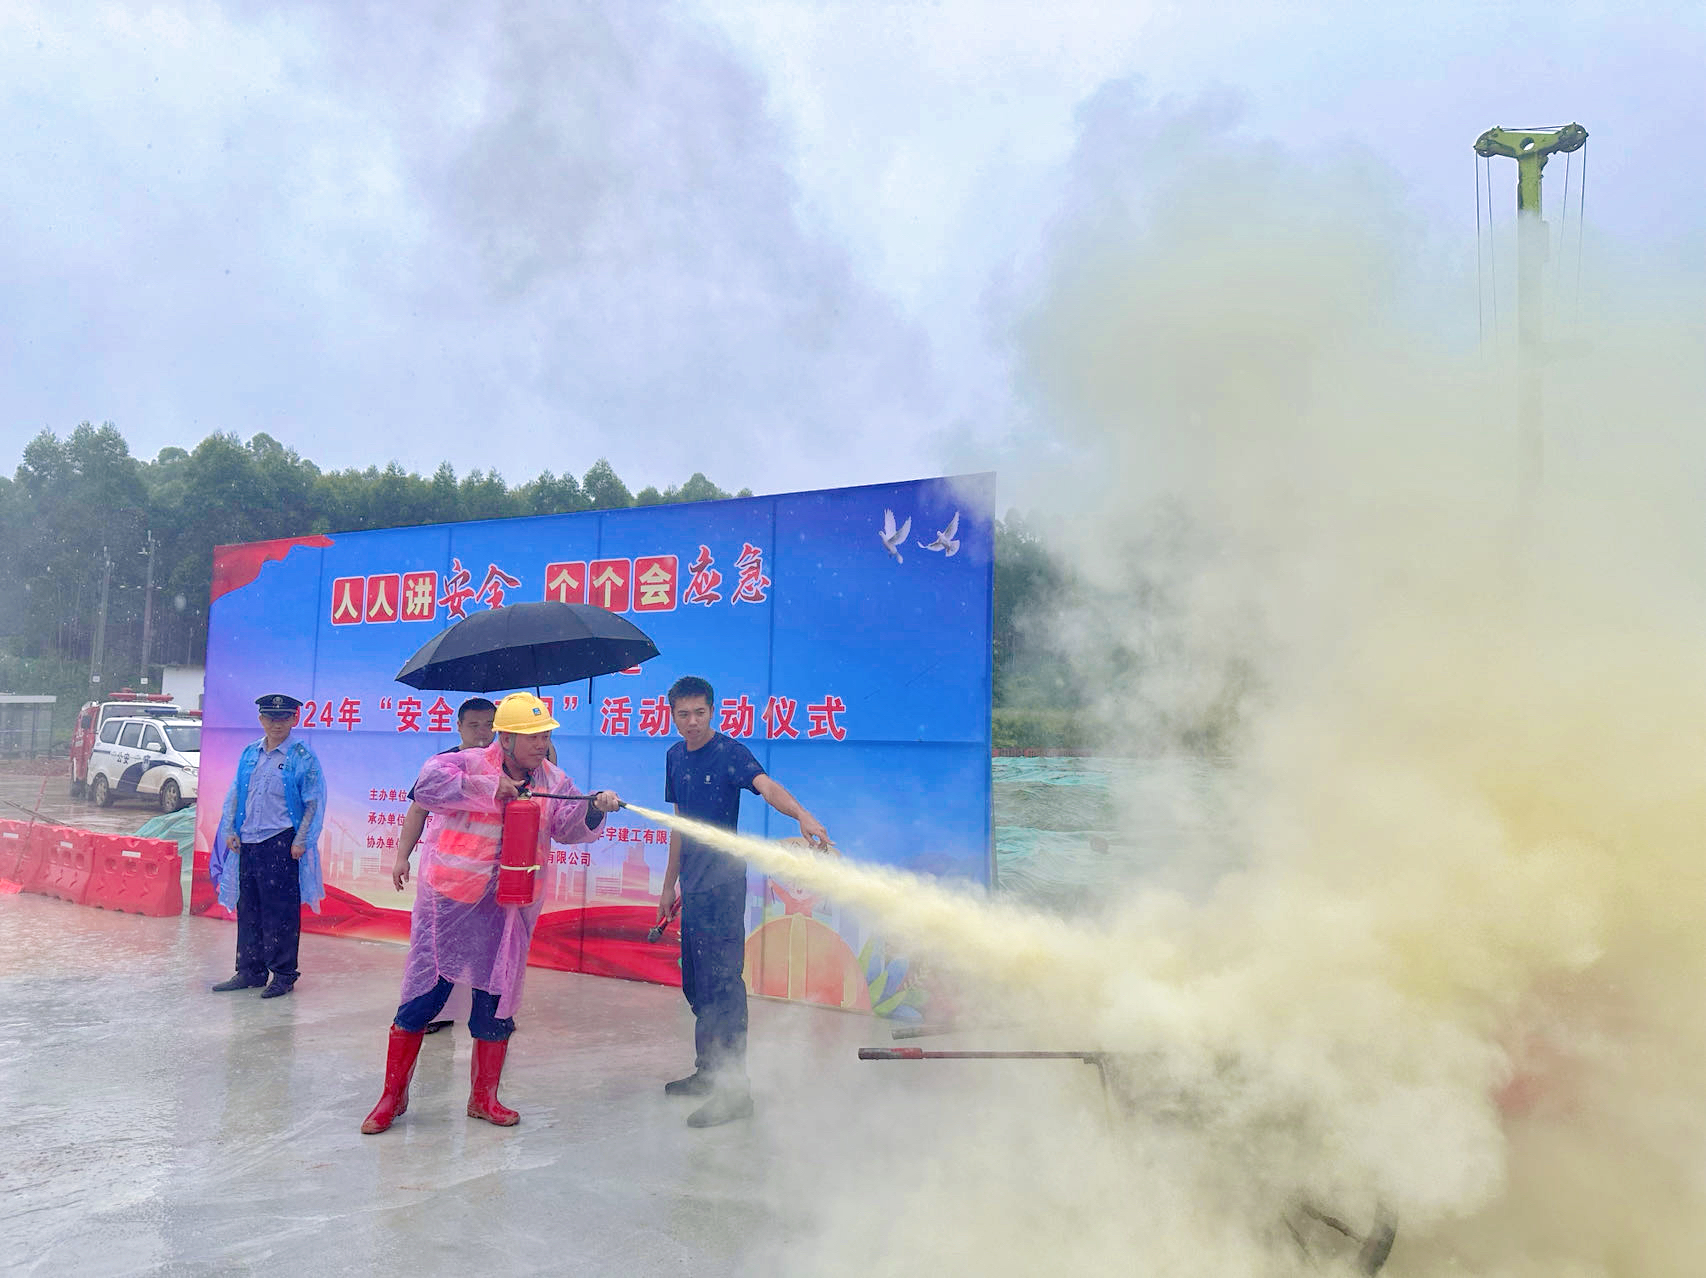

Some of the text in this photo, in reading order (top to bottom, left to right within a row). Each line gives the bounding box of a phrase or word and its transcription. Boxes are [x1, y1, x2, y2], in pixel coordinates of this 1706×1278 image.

[333, 543, 772, 622] 人人讲安全 个个会应急
[366, 836, 399, 850] 协办单
[598, 826, 672, 845] 宇建工有限
